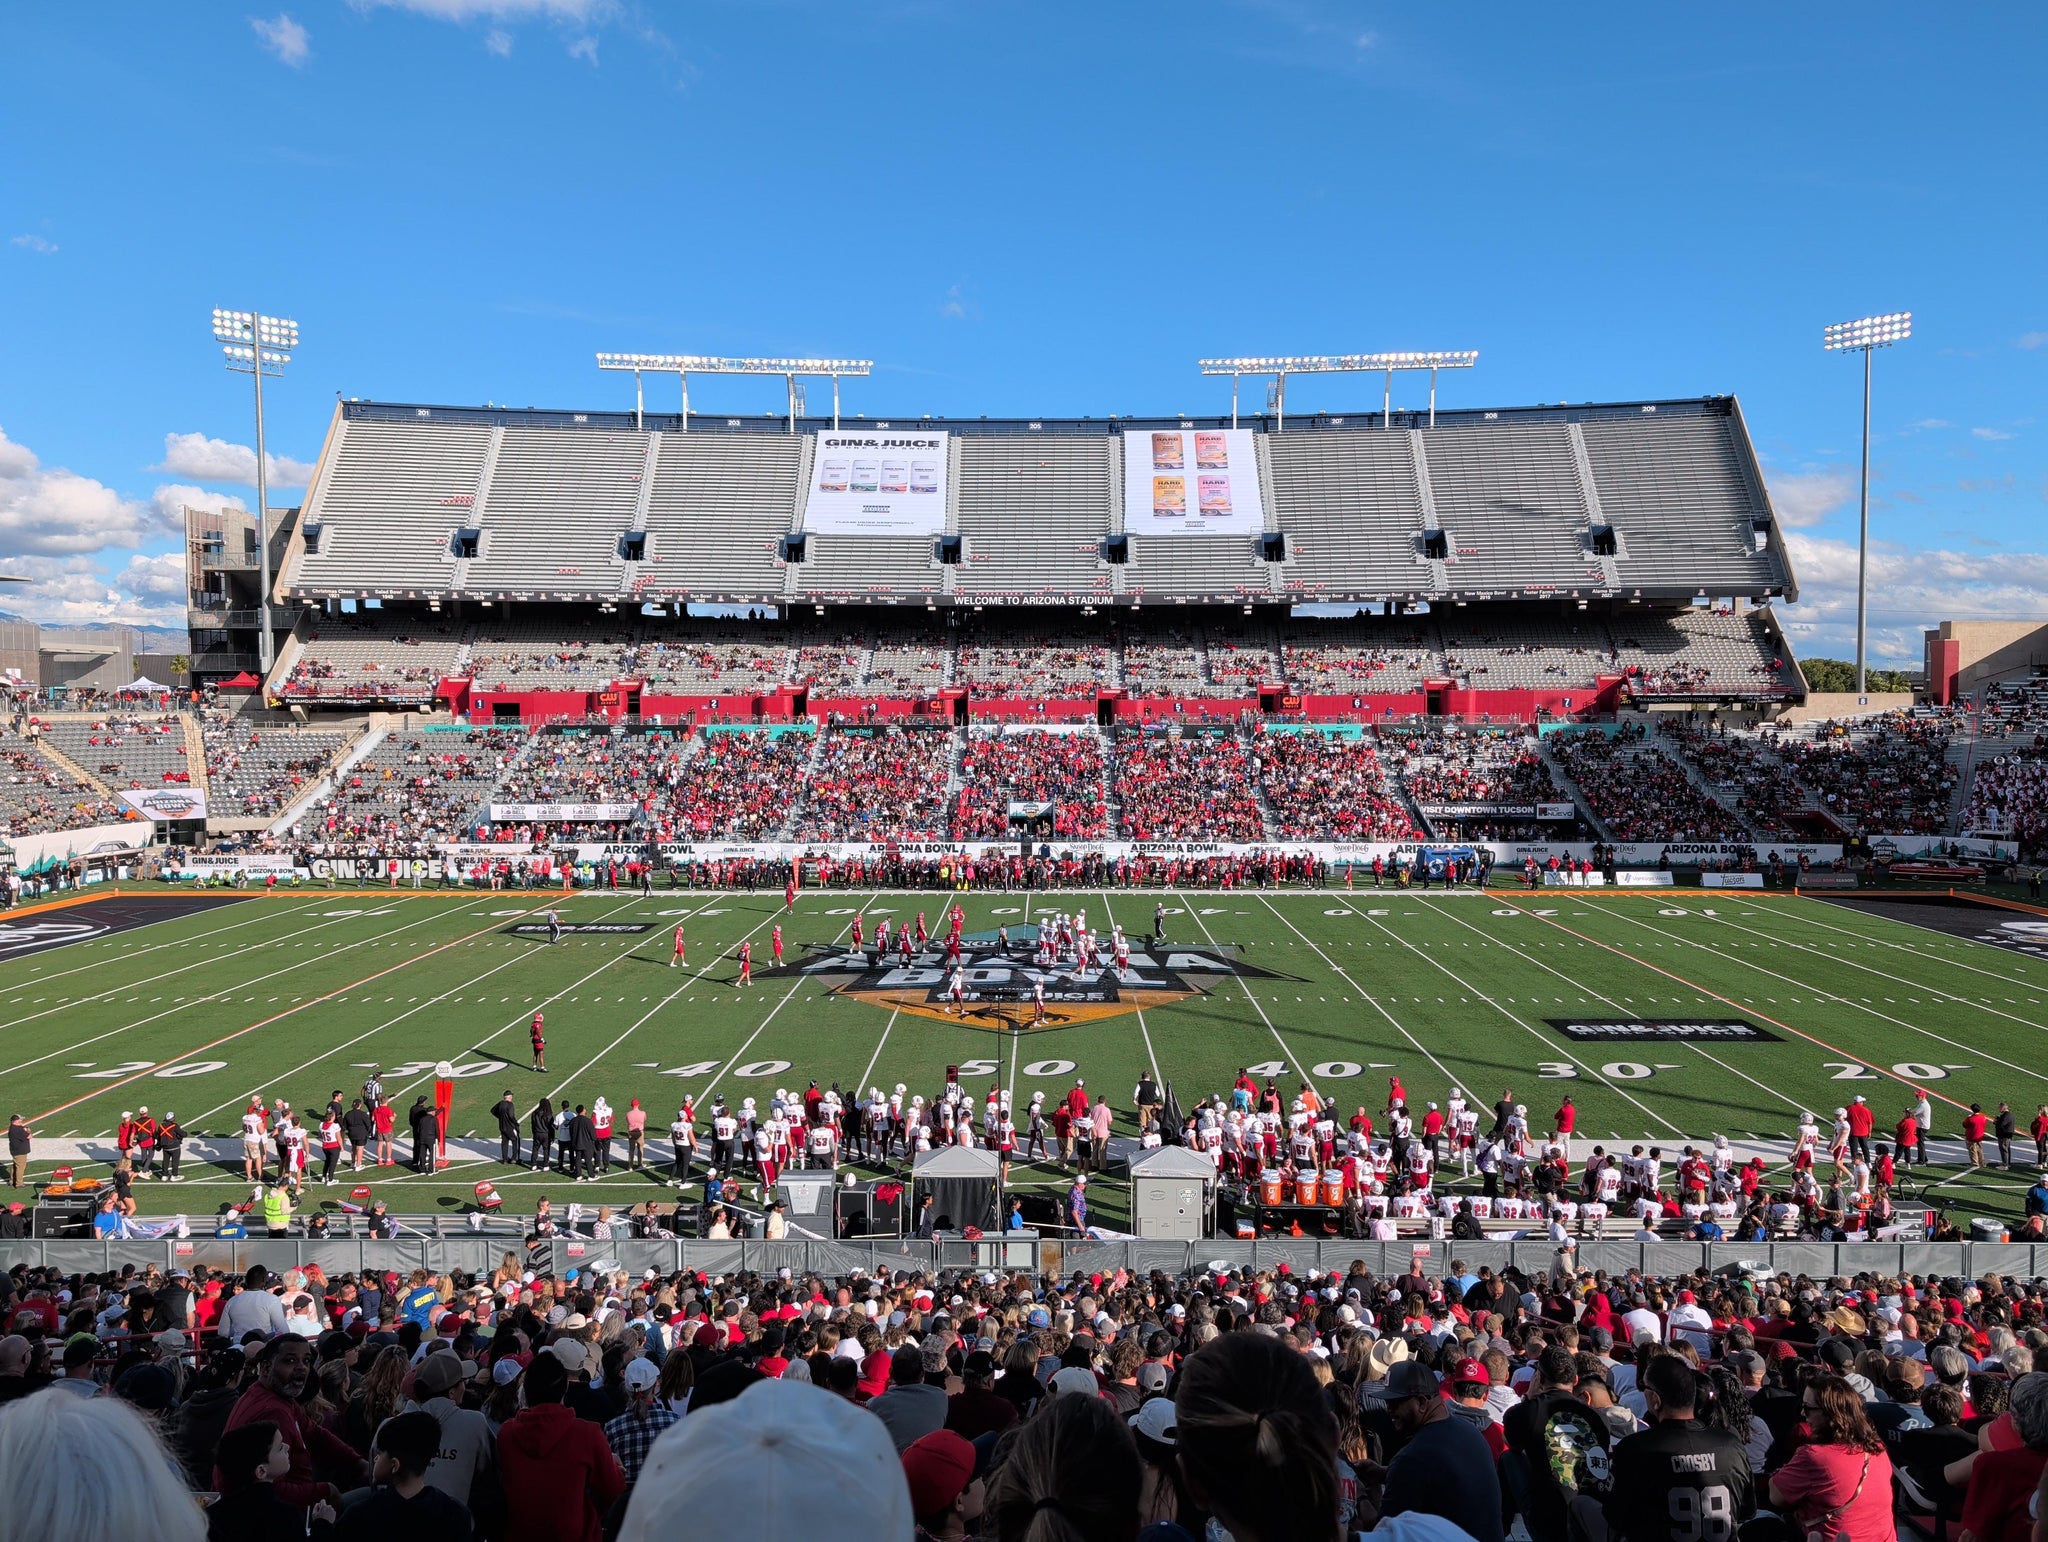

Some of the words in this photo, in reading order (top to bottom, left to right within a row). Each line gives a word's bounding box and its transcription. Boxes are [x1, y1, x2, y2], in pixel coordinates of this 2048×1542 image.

[954, 596, 1003, 604] WELCOME
[1006, 596, 1020, 604] TO
[1022, 596, 1066, 604] ARIZONA
[1069, 596, 1114, 604] STADIUM
[600, 694, 616, 702] CW
[1282, 696, 1300, 704] CW
[145, 798, 193, 806] ARIZONA
[604, 845, 650, 854] ARIZON
[662, 845, 695, 854] BOWL
[869, 844, 922, 853] ARONA
[925, 844, 958, 853] BOWL
[1130, 844, 1184, 852] ARIZONA
[1187, 844, 1222, 852] BOWL
[1663, 844, 1717, 854] ARIZONA
[312, 859, 442, 878] GIN&JUICE
[876, 968, 1167, 987] BOWL
[1566, 1024, 1753, 1034] GIN&JUICE
[70, 1061, 229, 1078] 20
[368, 1062, 510, 1078] 30
[657, 1061, 794, 1078] 40
[957, 1060, 1080, 1076] 50
[1237, 1061, 1366, 1078] 40
[1537, 1062, 1656, 1080] 30
[1823, 1062, 1951, 1080] 20
[874, 1112, 884, 1122] 21
[1464, 1120, 1473, 1130] 13
[323, 1132, 332, 1142] 15
[1323, 1130, 1332, 1140] 16
[287, 1138, 298, 1146] 28
[816, 1137, 828, 1146] 53
[1209, 1138, 1220, 1150] 58
[1401, 1206, 1413, 1218] 47
[1474, 1204, 1488, 1216] 22
[414, 1292, 434, 1308] SECURITY
[1671, 1453, 1716, 1473] CROSBY
[1668, 1485, 1732, 1542] 98
